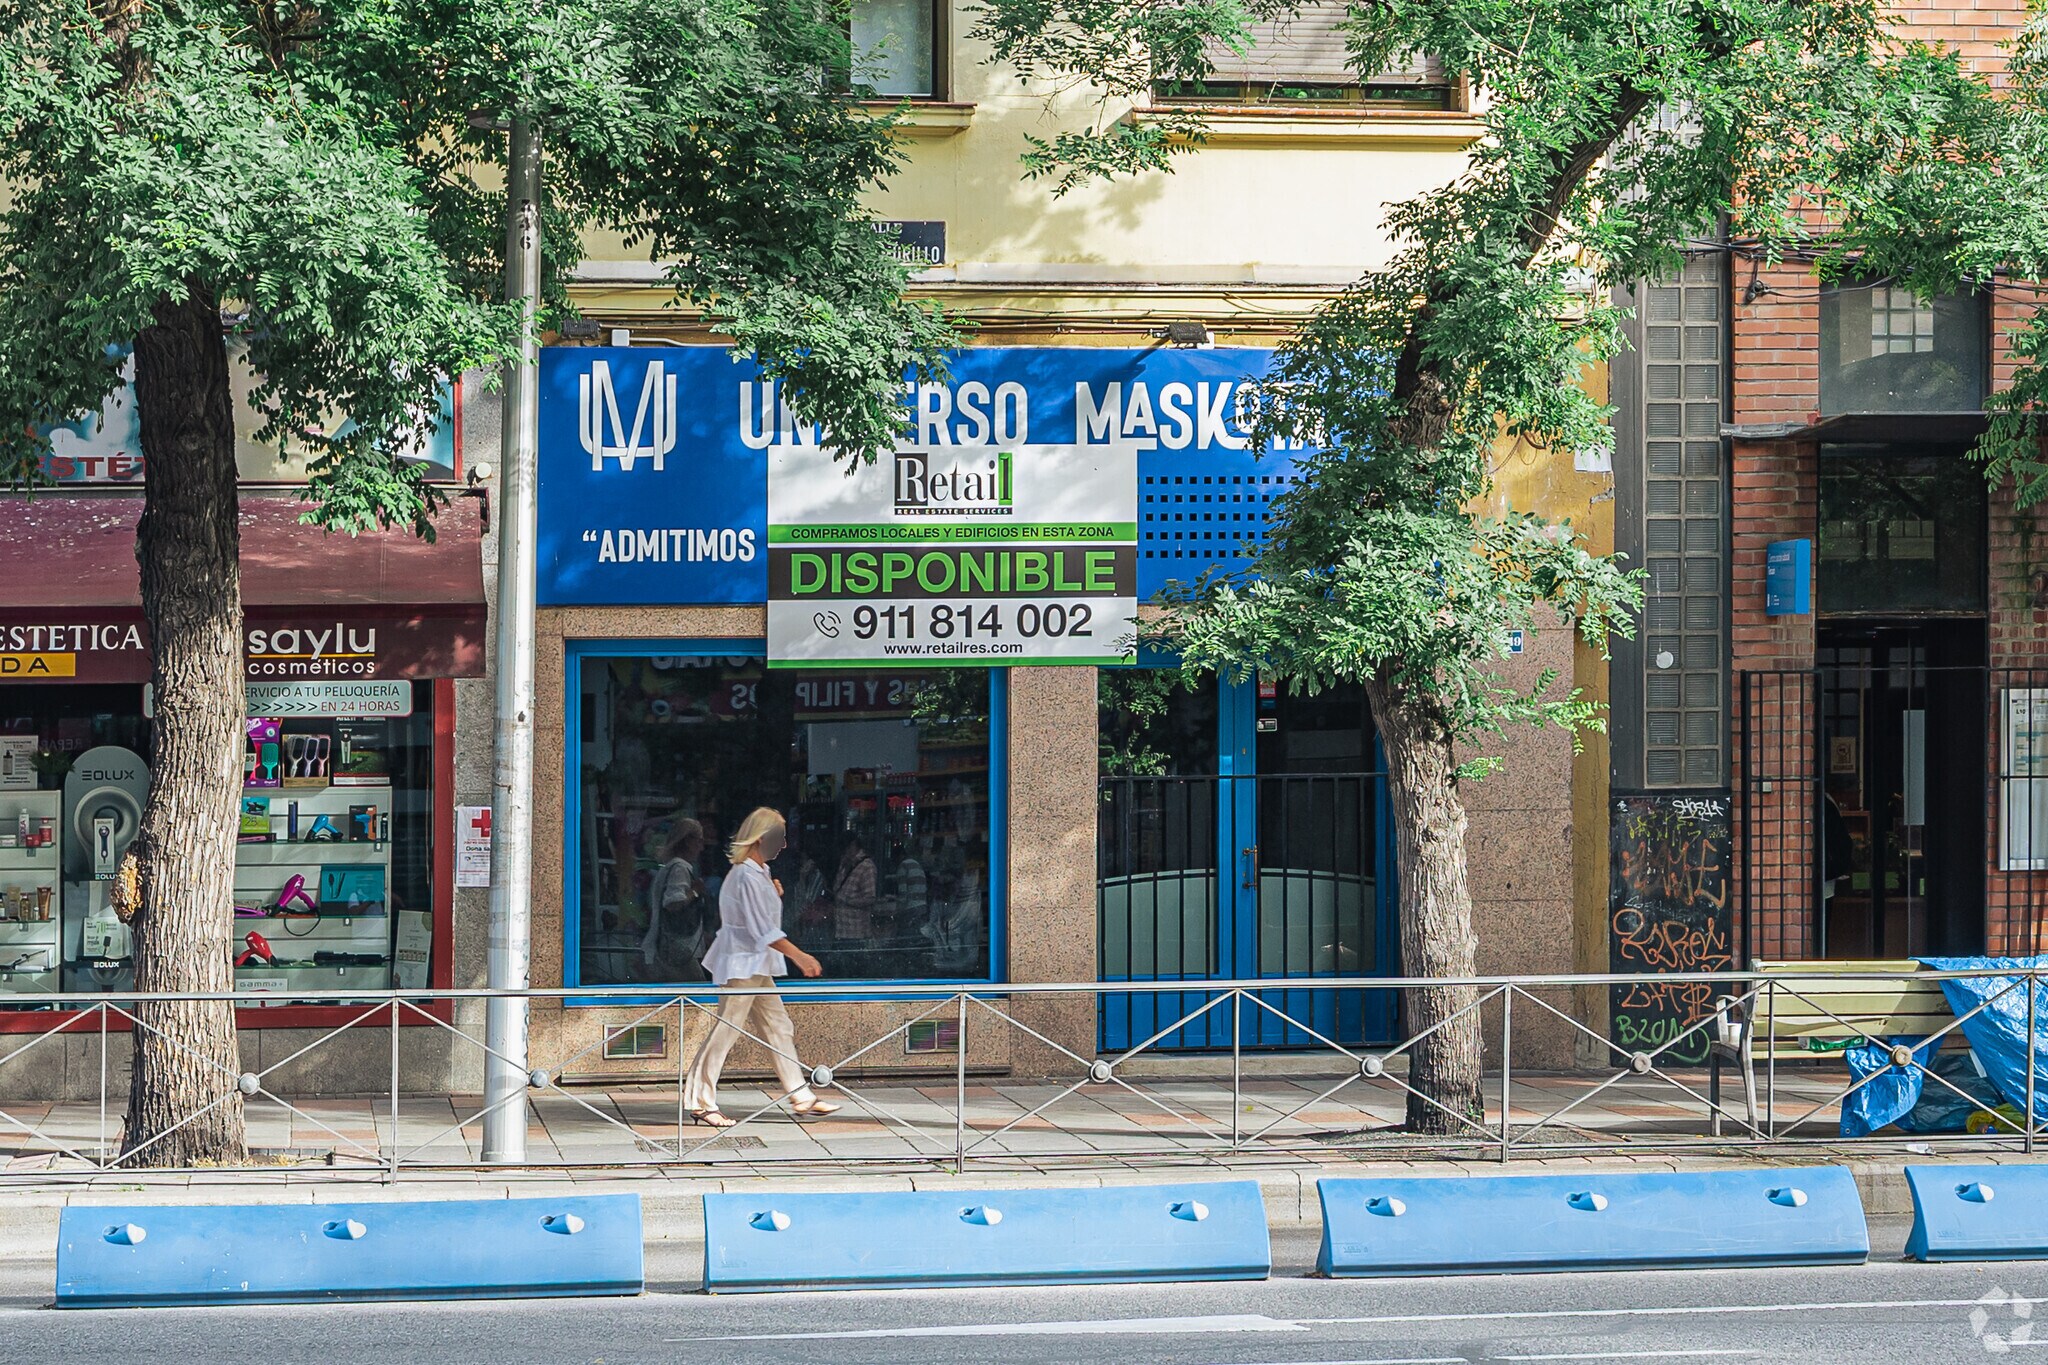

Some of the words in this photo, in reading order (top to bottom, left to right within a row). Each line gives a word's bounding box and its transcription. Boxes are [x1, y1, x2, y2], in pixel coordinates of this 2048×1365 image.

[869, 222, 903, 234] ALLE
[739, 381, 1029, 450] UNERSO
[897, 457, 1012, 502] Retail
[791, 528, 878, 539] COMPRAMOS
[881, 527, 940, 538] LOCALES
[943, 527, 952, 538] Y
[955, 527, 1018, 538] EDIFICIOS
[1022, 527, 1039, 537] EN
[1043, 527, 1075, 537] ESTA
[1078, 526, 1114, 537] ZONA
[791, 551, 1116, 594] DISPONIBLE
[853, 604, 915, 640] 911
[929, 603, 1002, 639] 814
[1016, 603, 1093, 638] 002
[0, 623, 145, 651] STETICA
[248, 622, 376, 660] saylu
[884, 641, 1023, 655] www.retailres.com
[248, 658, 375, 675] cosméticos
[245, 686, 291, 698] ERVICIO
[294, 686, 303, 697] A
[305, 686, 321, 697] TU
[325, 683, 400, 698] PELUQUERÍA
[321, 701, 337, 712] EN
[341, 701, 355, 712] 24
[358, 700, 400, 712] HORAS
